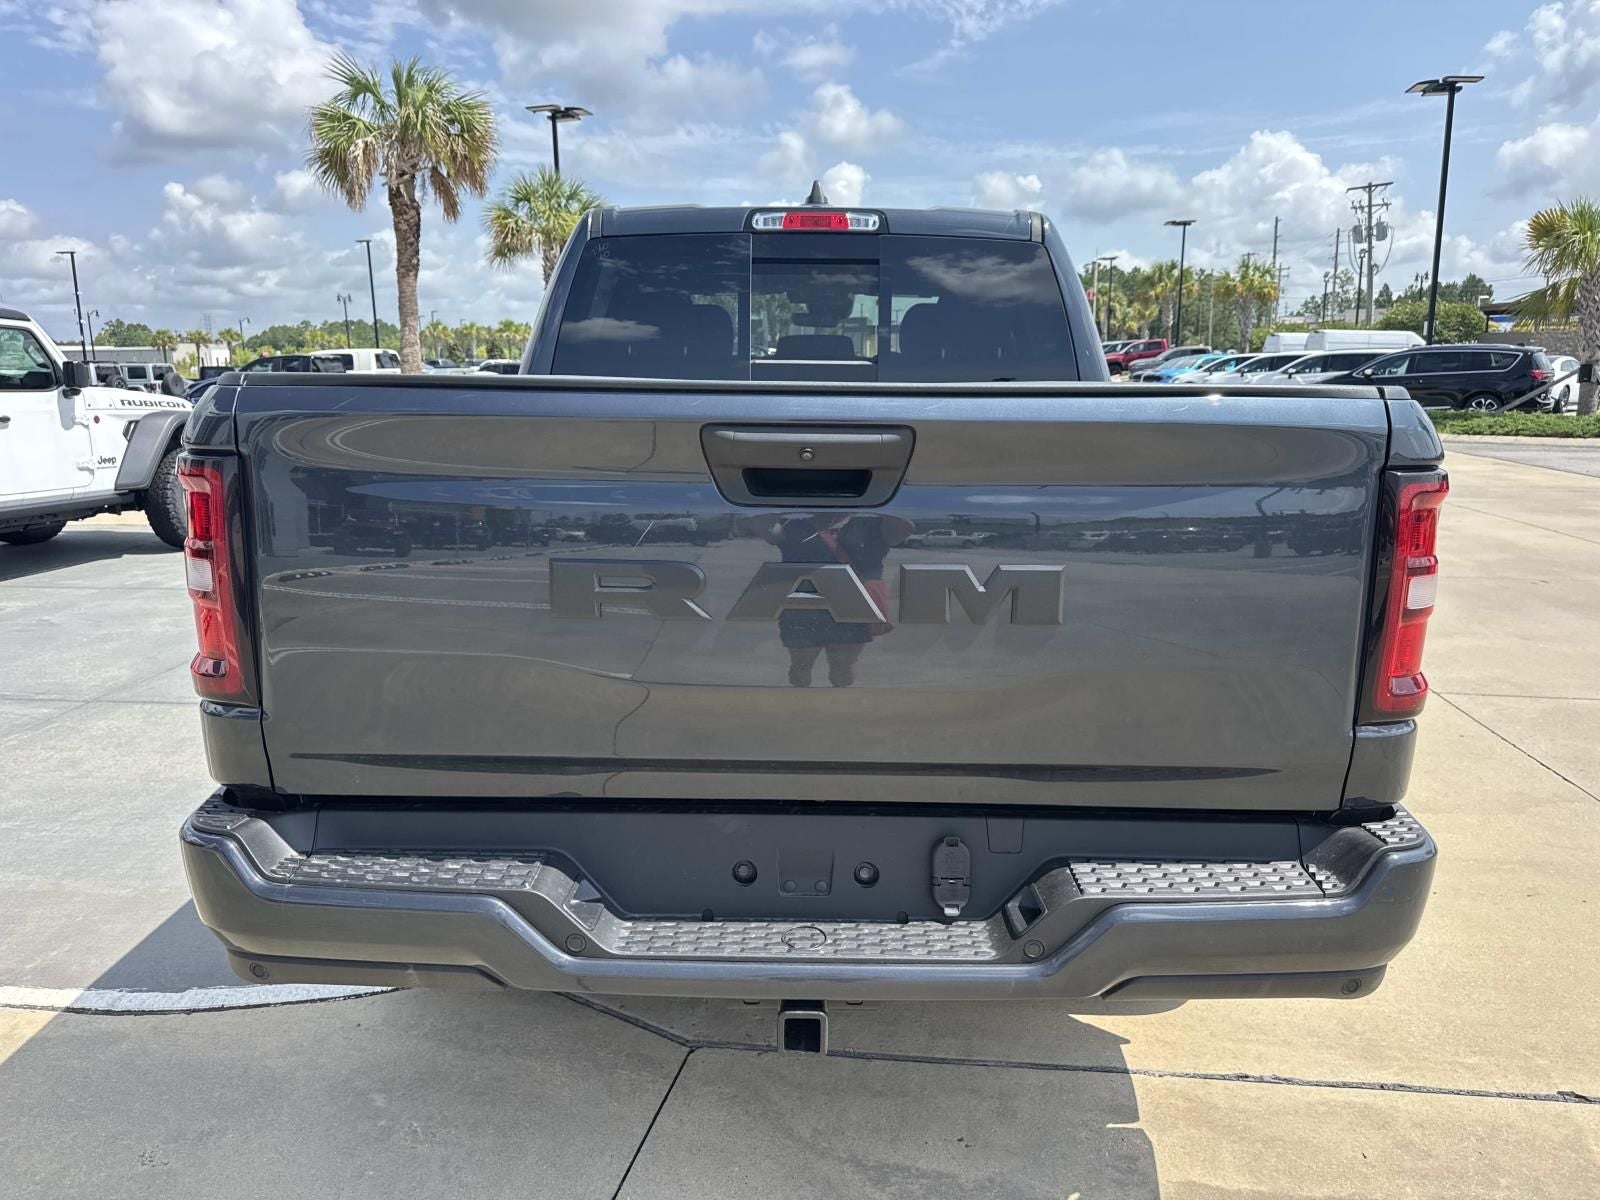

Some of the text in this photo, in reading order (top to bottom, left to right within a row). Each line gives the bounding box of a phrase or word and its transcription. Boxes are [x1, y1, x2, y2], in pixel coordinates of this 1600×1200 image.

[120, 399, 186, 409] RUBICON
[97, 455, 117, 465] Jeep
[549, 558, 1066, 624] RAM
